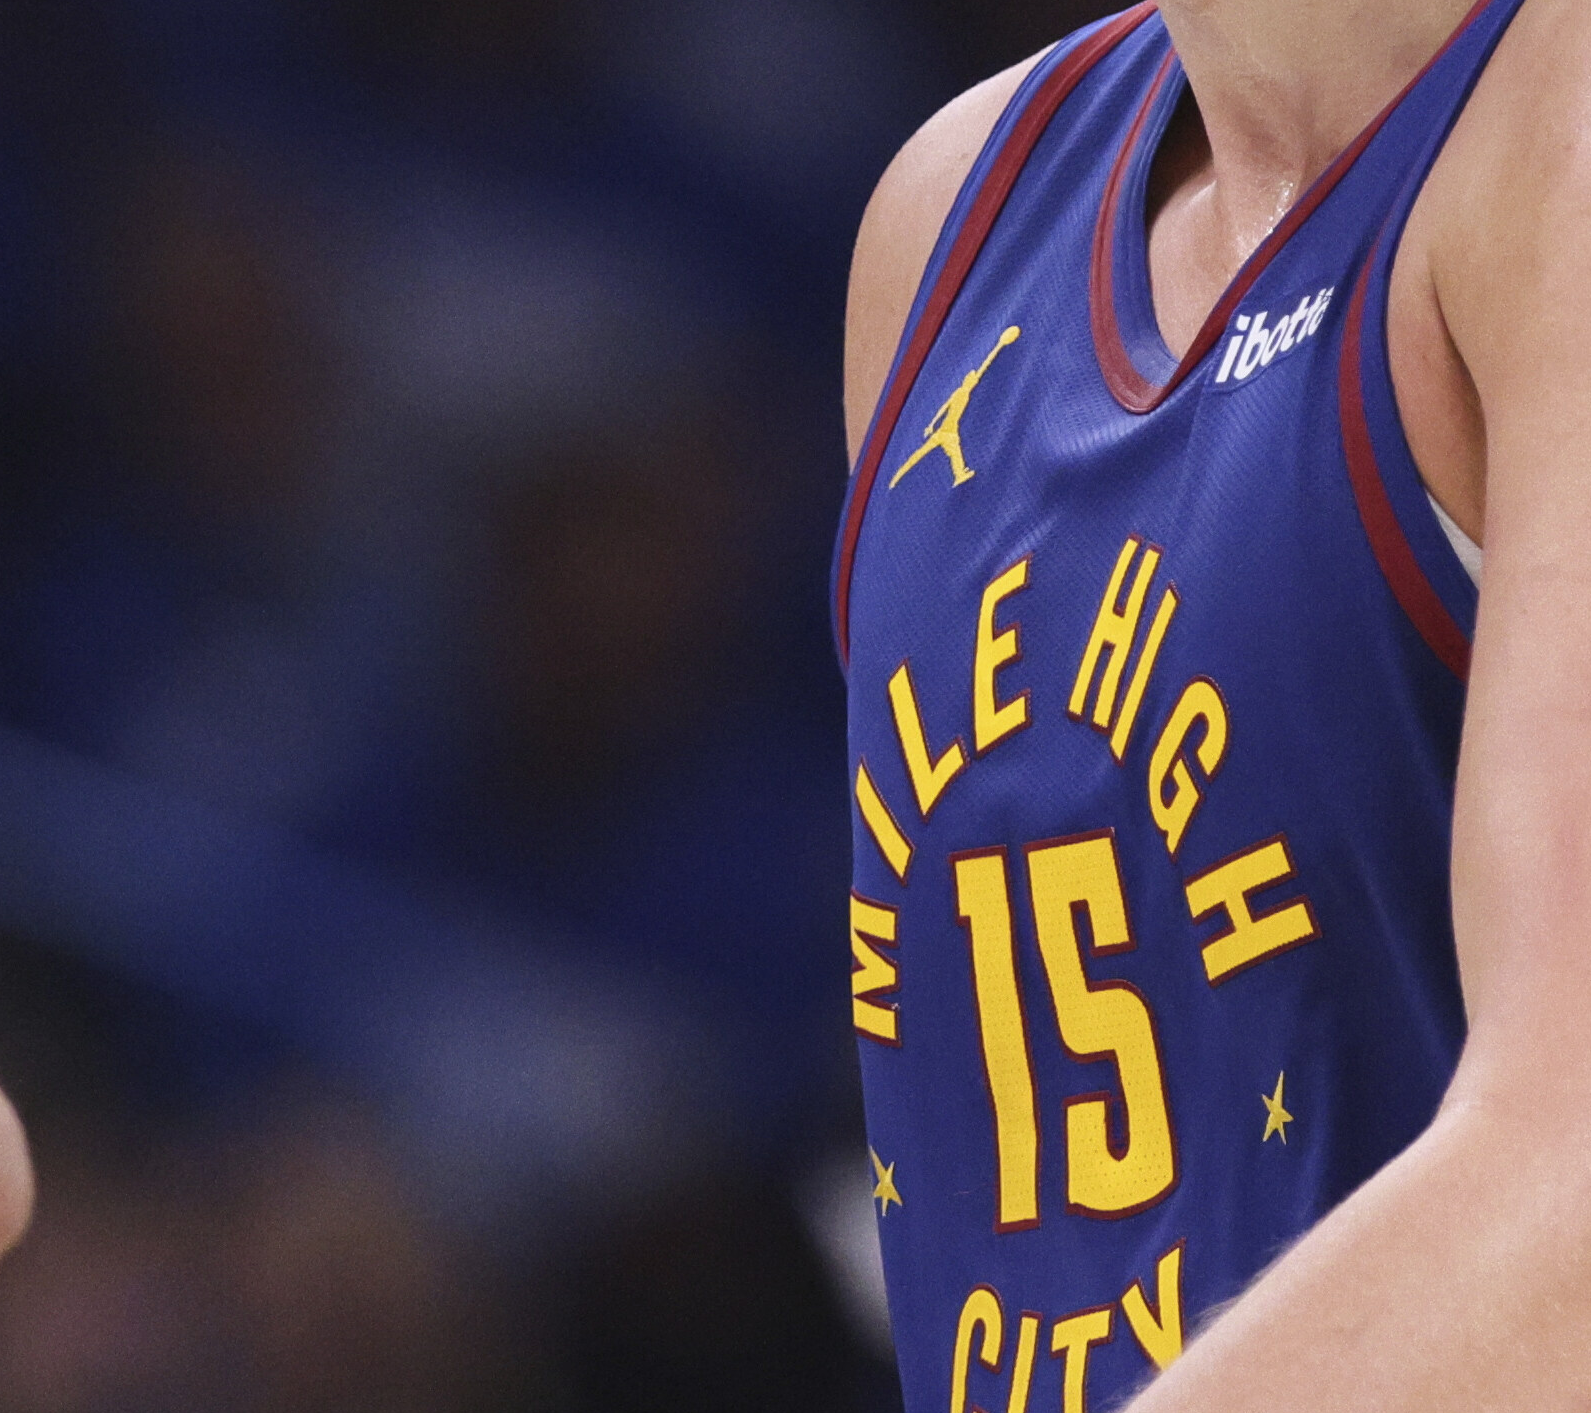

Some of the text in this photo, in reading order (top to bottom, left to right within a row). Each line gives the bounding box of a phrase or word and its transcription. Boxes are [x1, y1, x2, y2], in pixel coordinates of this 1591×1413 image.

[850, 536, 1323, 1046] MILE HIGH
[949, 829, 1183, 1232] 15
